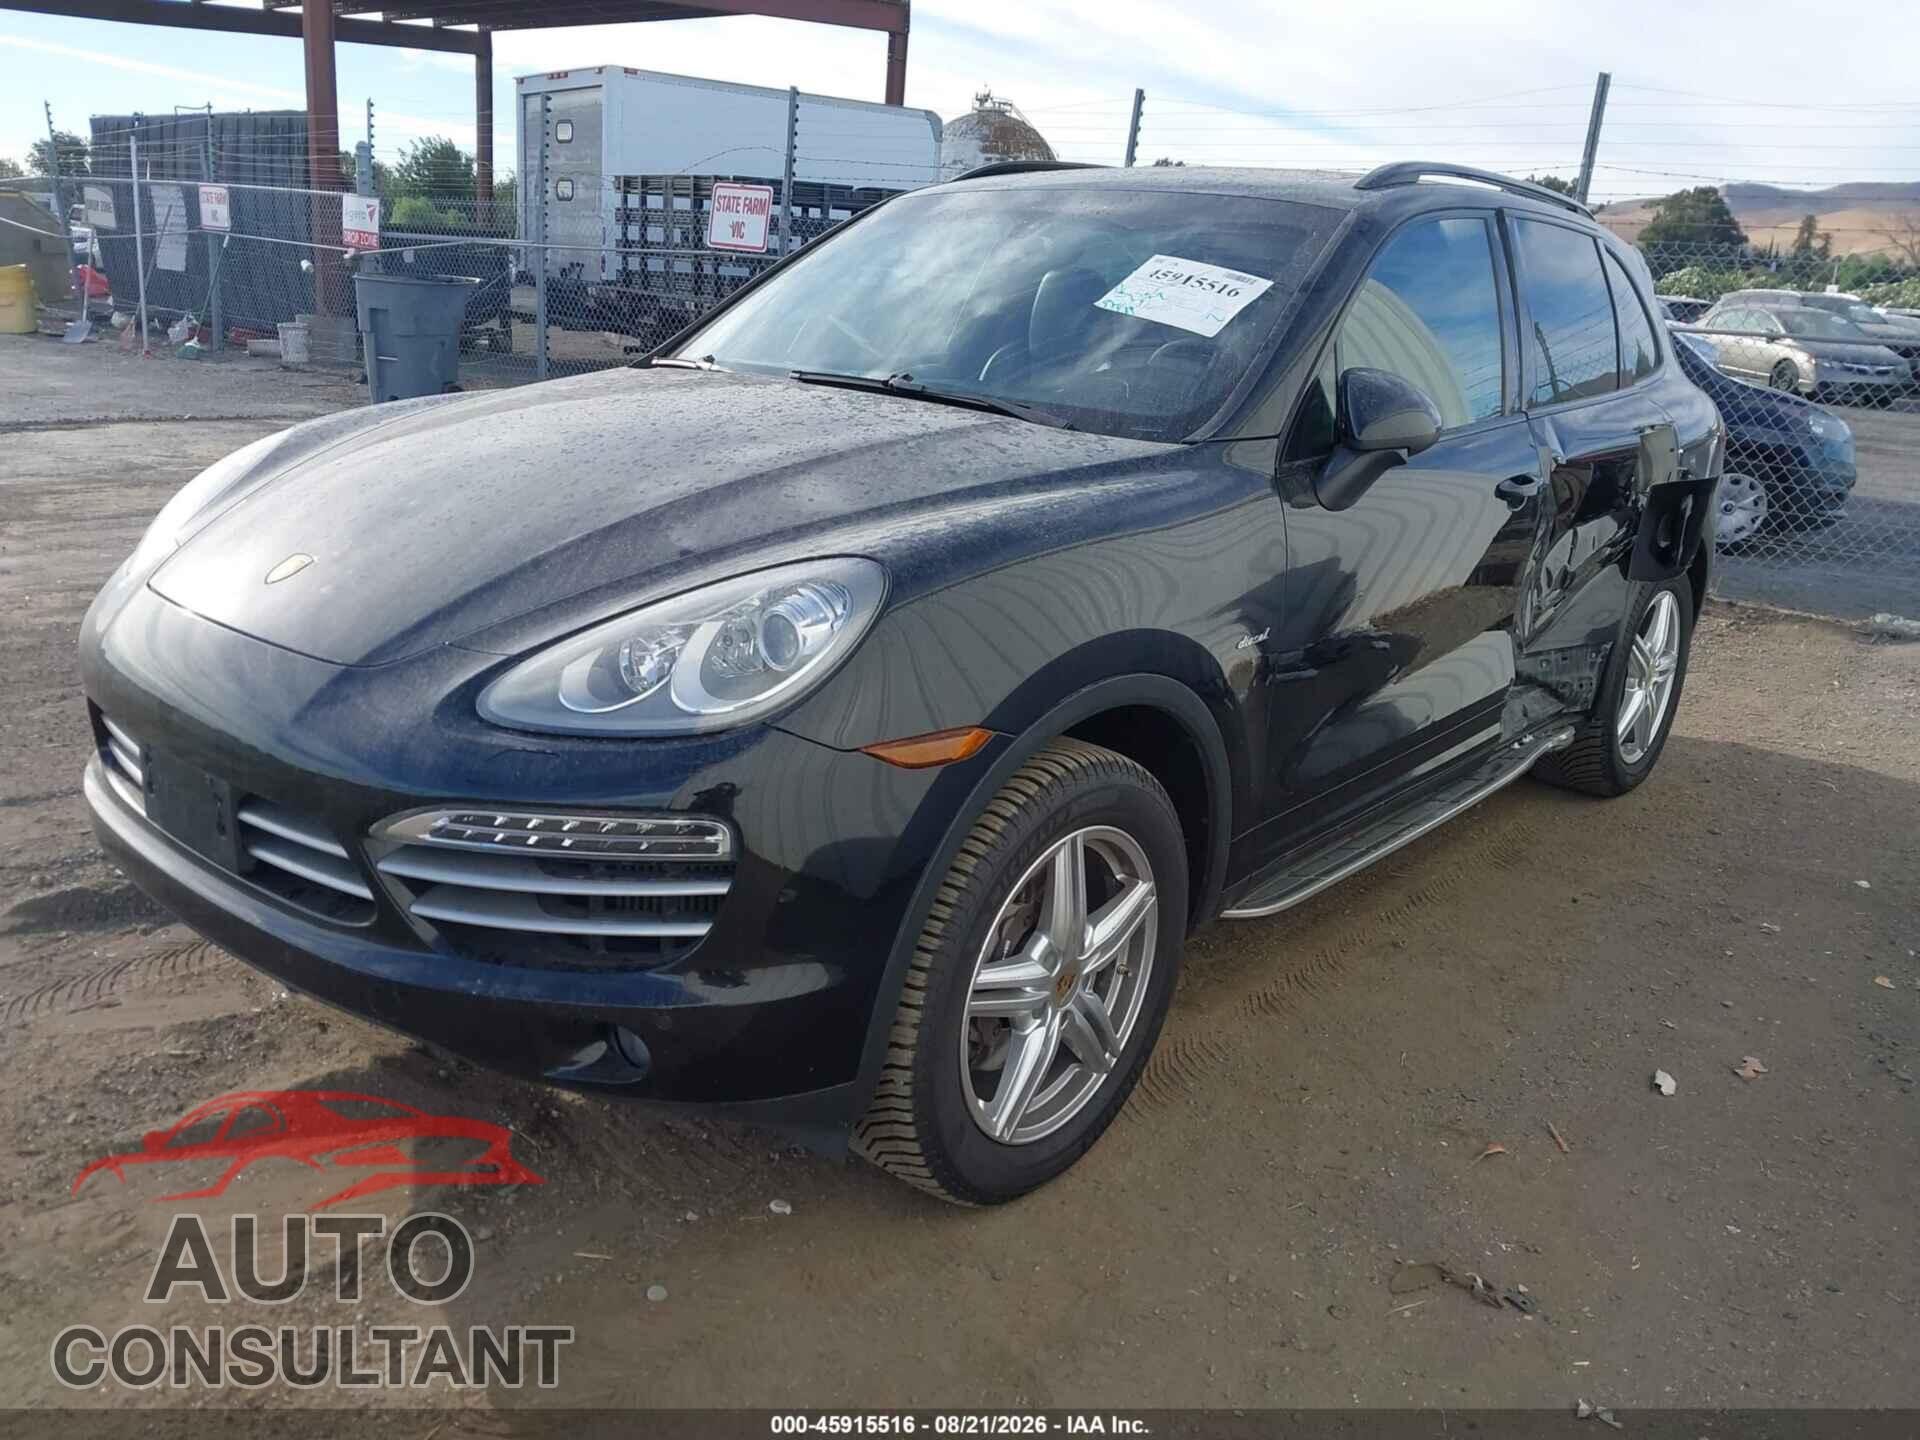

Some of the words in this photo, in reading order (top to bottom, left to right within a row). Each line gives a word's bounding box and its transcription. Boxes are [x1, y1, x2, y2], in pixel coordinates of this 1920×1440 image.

[716, 195, 741, 214] STATE
[742, 197, 767, 216] FARM
[1237, 626, 1270, 649] diesel
